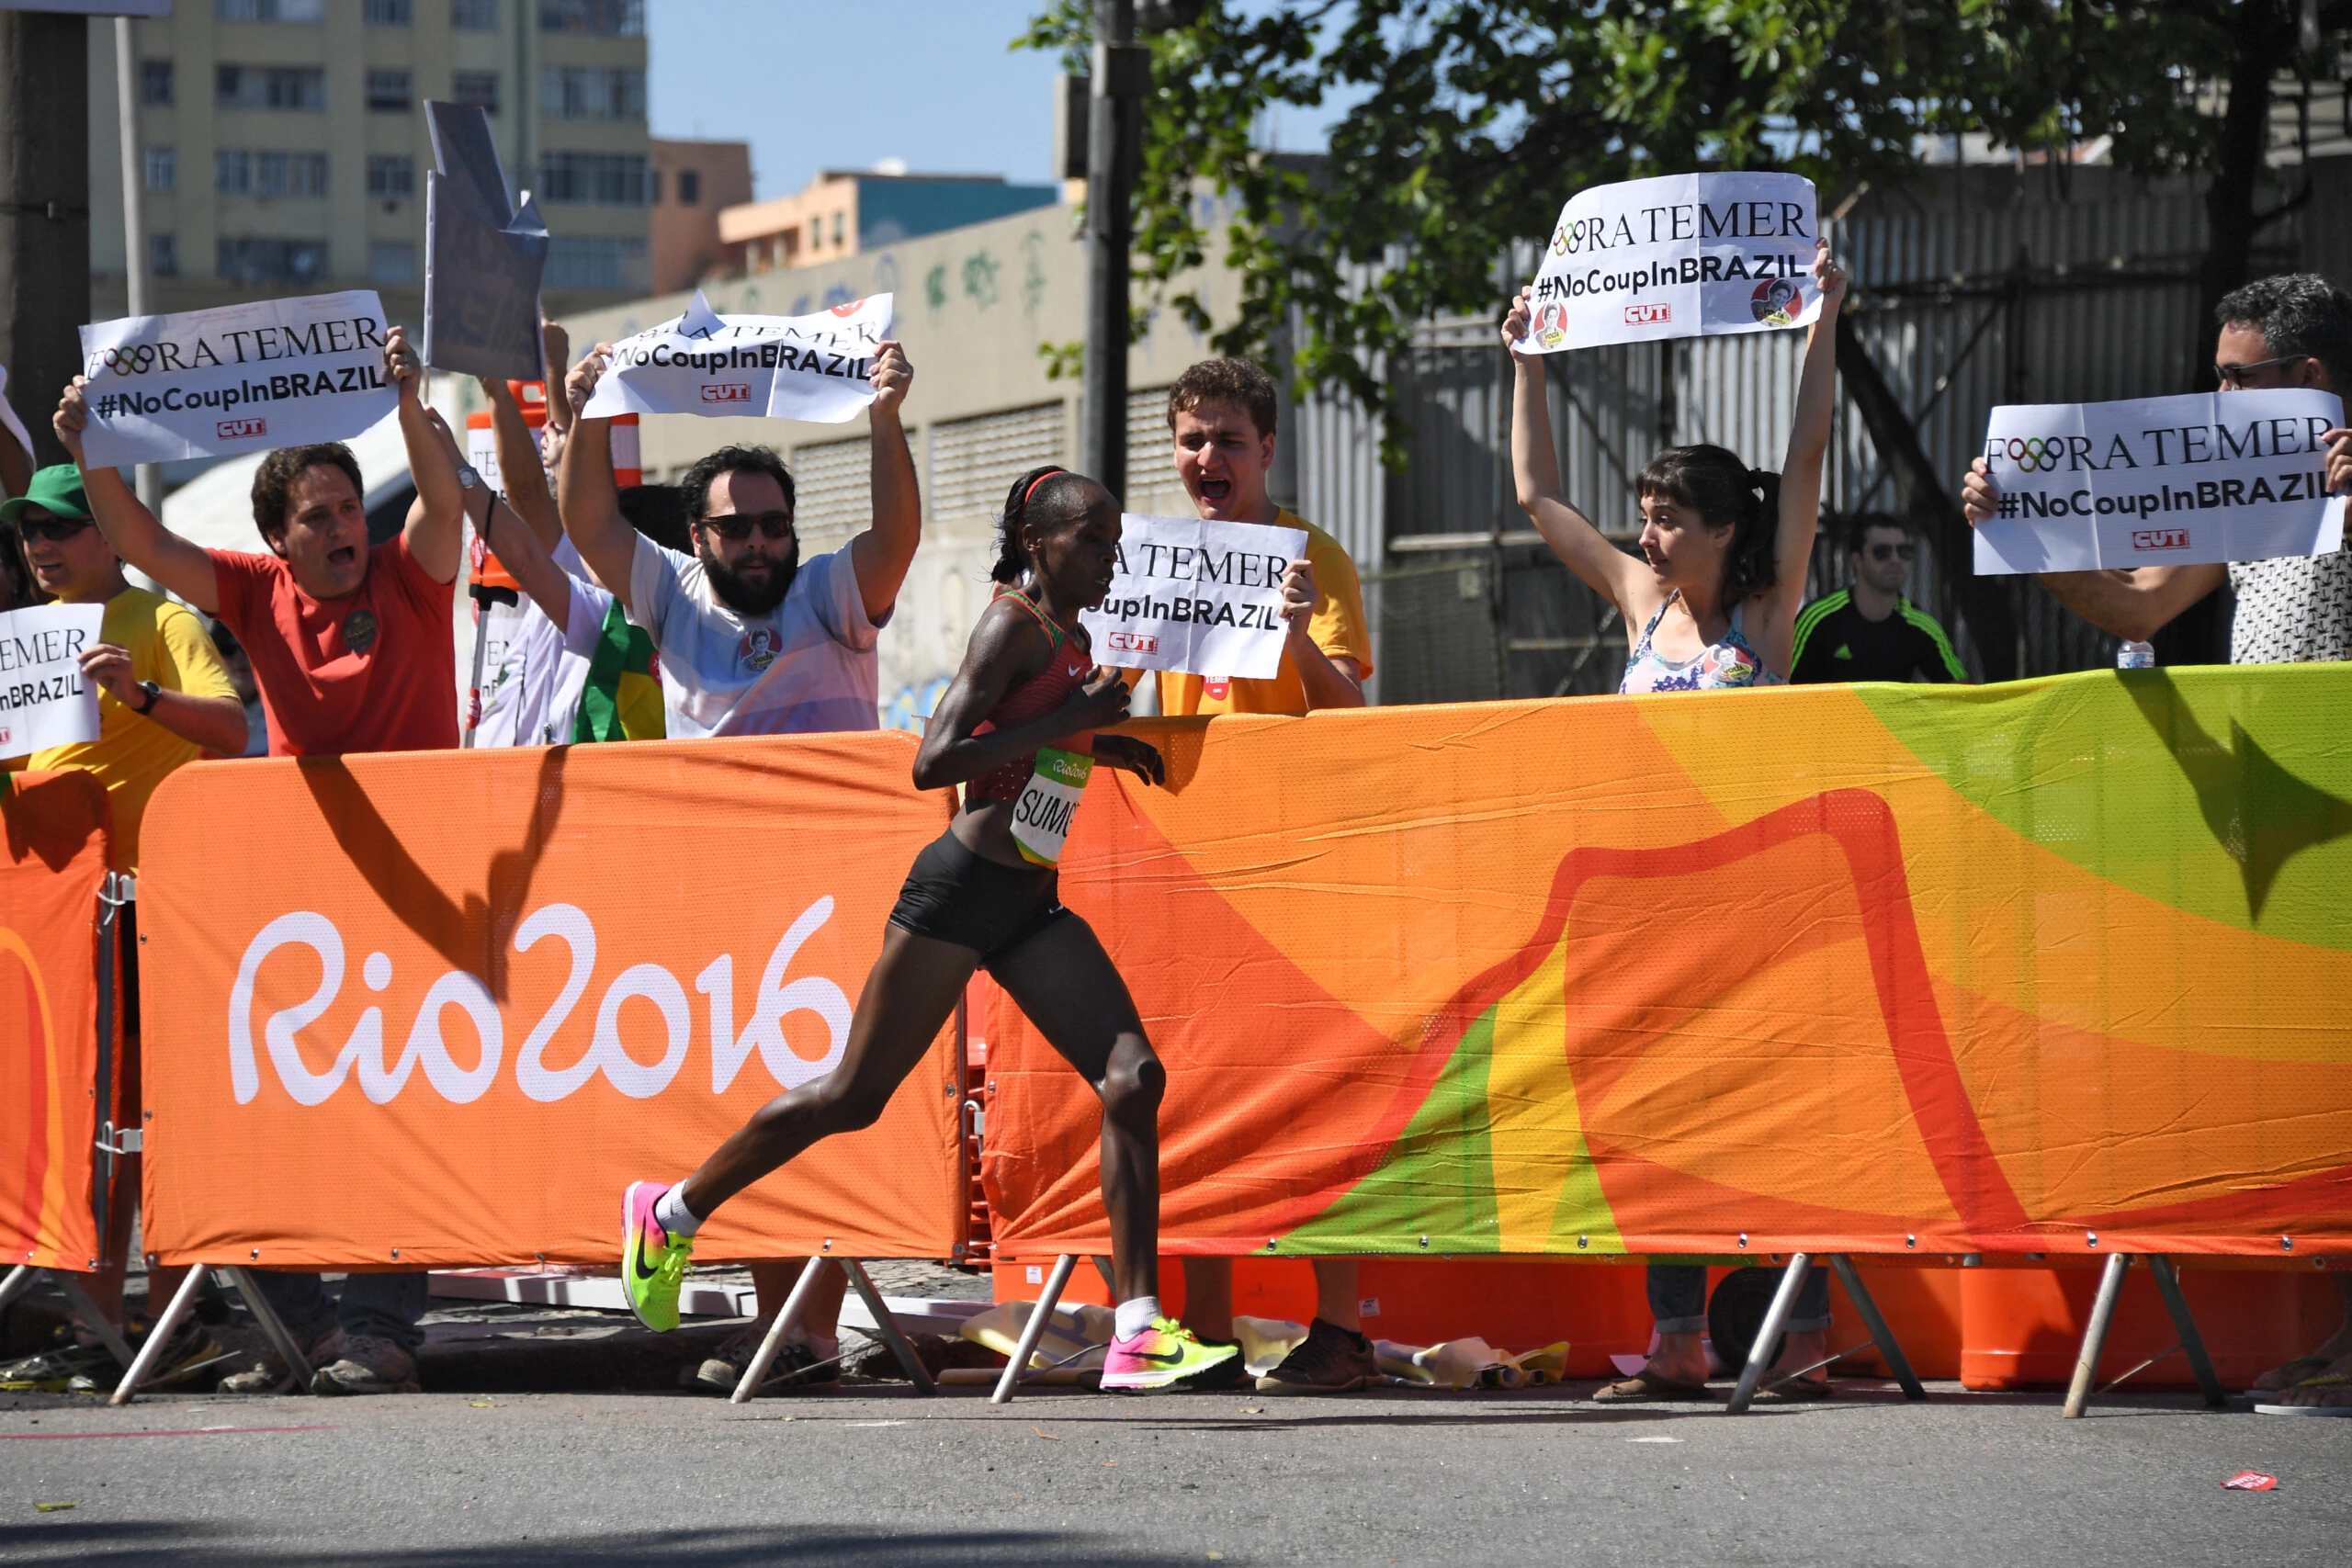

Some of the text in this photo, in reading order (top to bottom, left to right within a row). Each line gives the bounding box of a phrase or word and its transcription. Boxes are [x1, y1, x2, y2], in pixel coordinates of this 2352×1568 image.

[1641, 201, 1811, 243] TEMER
[1537, 254, 1806, 303] #NoCoupInBRAZIL
[1624, 302, 1668, 322] CUT
[221, 316, 387, 364] TEMER
[726, 320, 879, 351] TEMER
[614, 344, 872, 381] NoCoupInBRAZIL
[96, 365, 387, 420] #NoCoupInBRAZIL
[701, 383, 748, 400] CUT
[217, 418, 262, 438] CUT
[2142, 416, 2335, 467] TEMER
[1997, 470, 2336, 520] #NoCoupInBRAZIL
[2132, 528, 2185, 549] CUT
[1139, 543, 1288, 589] TEMER
[1108, 631, 1155, 652] CUT
